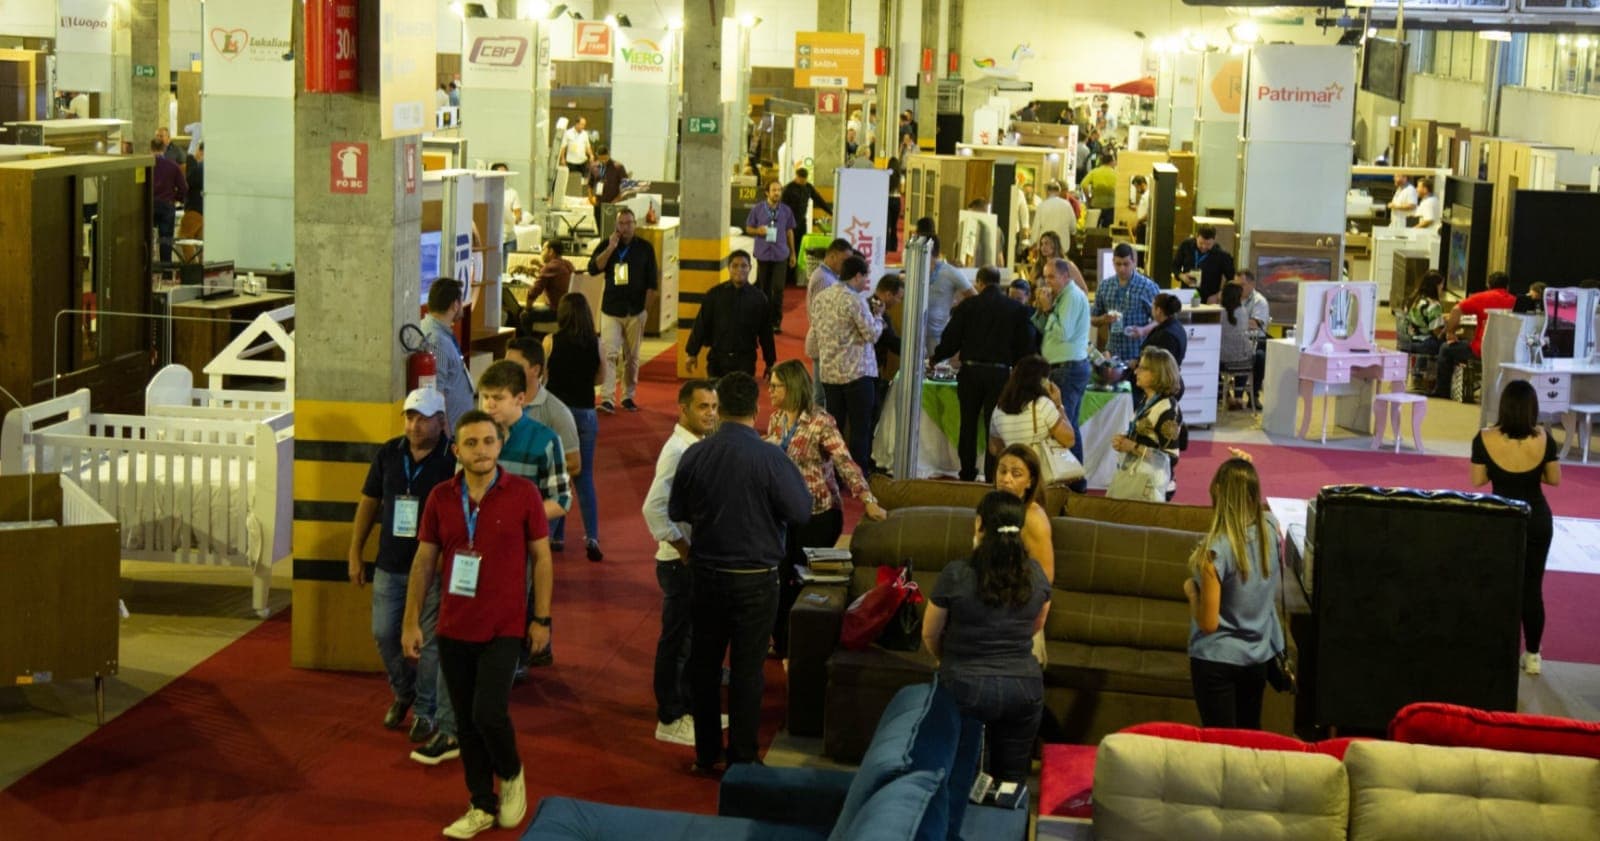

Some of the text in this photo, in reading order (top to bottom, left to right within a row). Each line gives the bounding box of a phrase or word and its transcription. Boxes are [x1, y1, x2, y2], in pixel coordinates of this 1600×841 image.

[480, 45, 517, 57] CBP
[621, 48, 664, 65] VIERO
[1258, 85, 1334, 103] Patrimar
